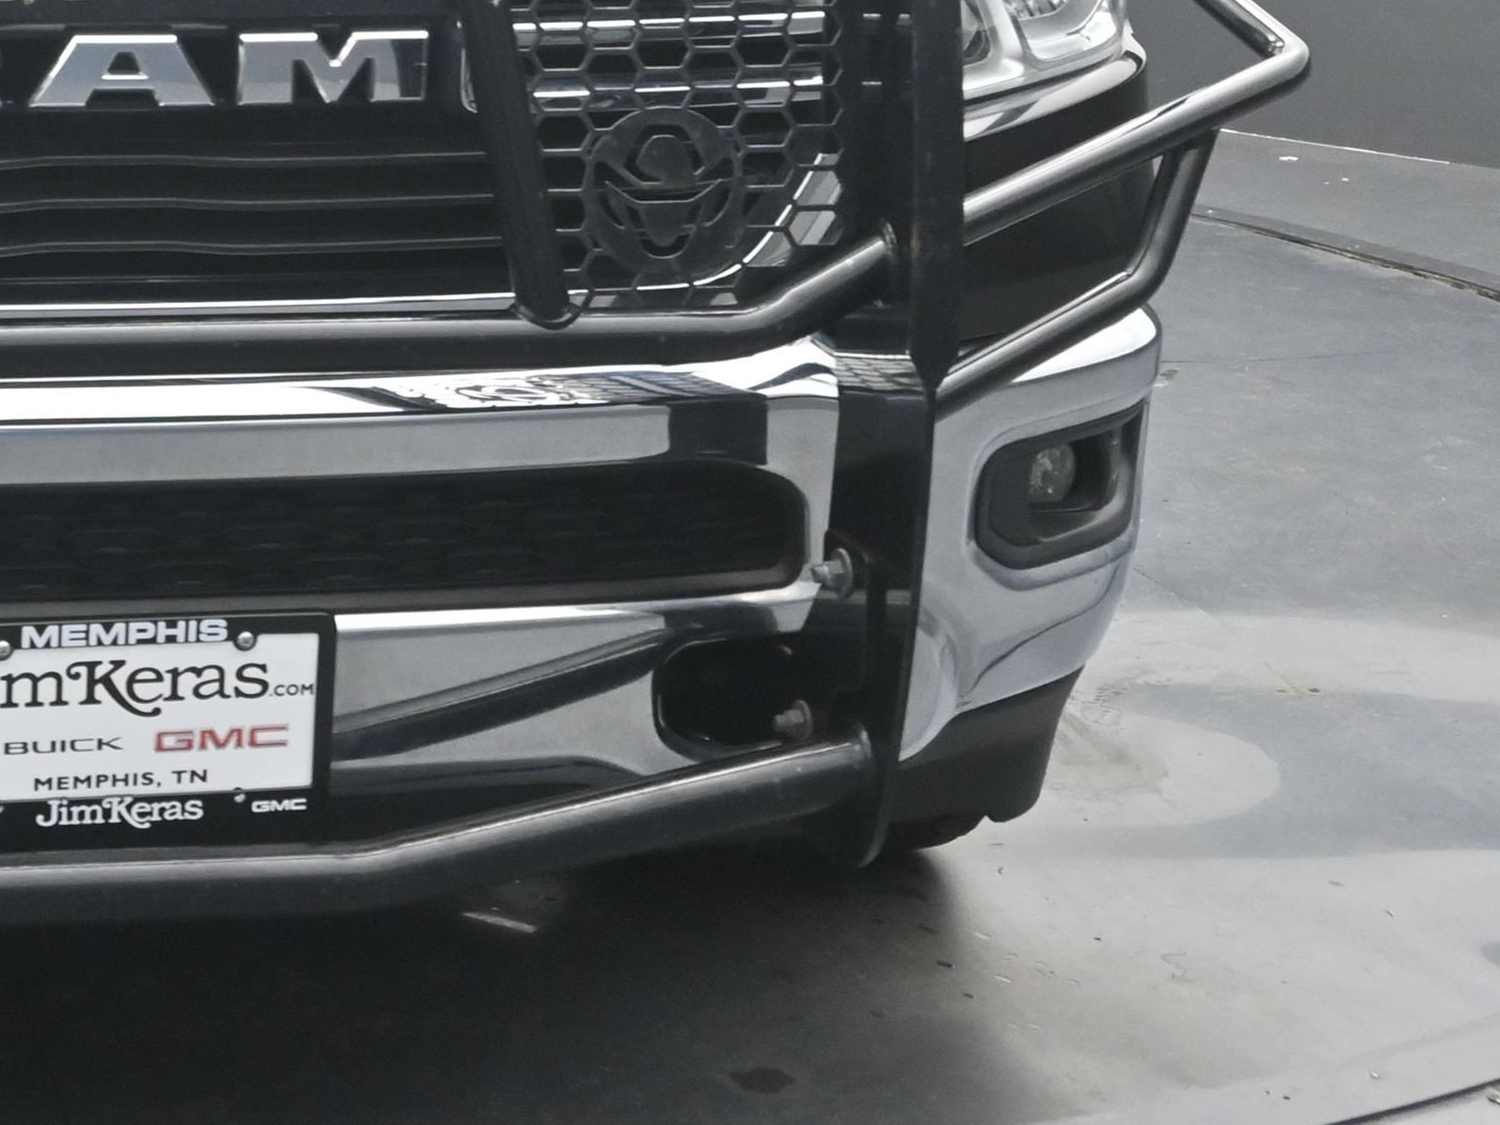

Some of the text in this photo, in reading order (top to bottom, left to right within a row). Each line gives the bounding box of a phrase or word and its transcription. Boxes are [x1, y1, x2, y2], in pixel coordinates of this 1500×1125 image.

[20, 619, 228, 649] MEMPHIS
[3, 736, 123, 756] BUICK
[154, 724, 289, 753] GMC
[34, 769, 208, 791] MEMPHIS, TN
[36, 796, 204, 829] JimKeras
[251, 798, 308, 813] GMC
